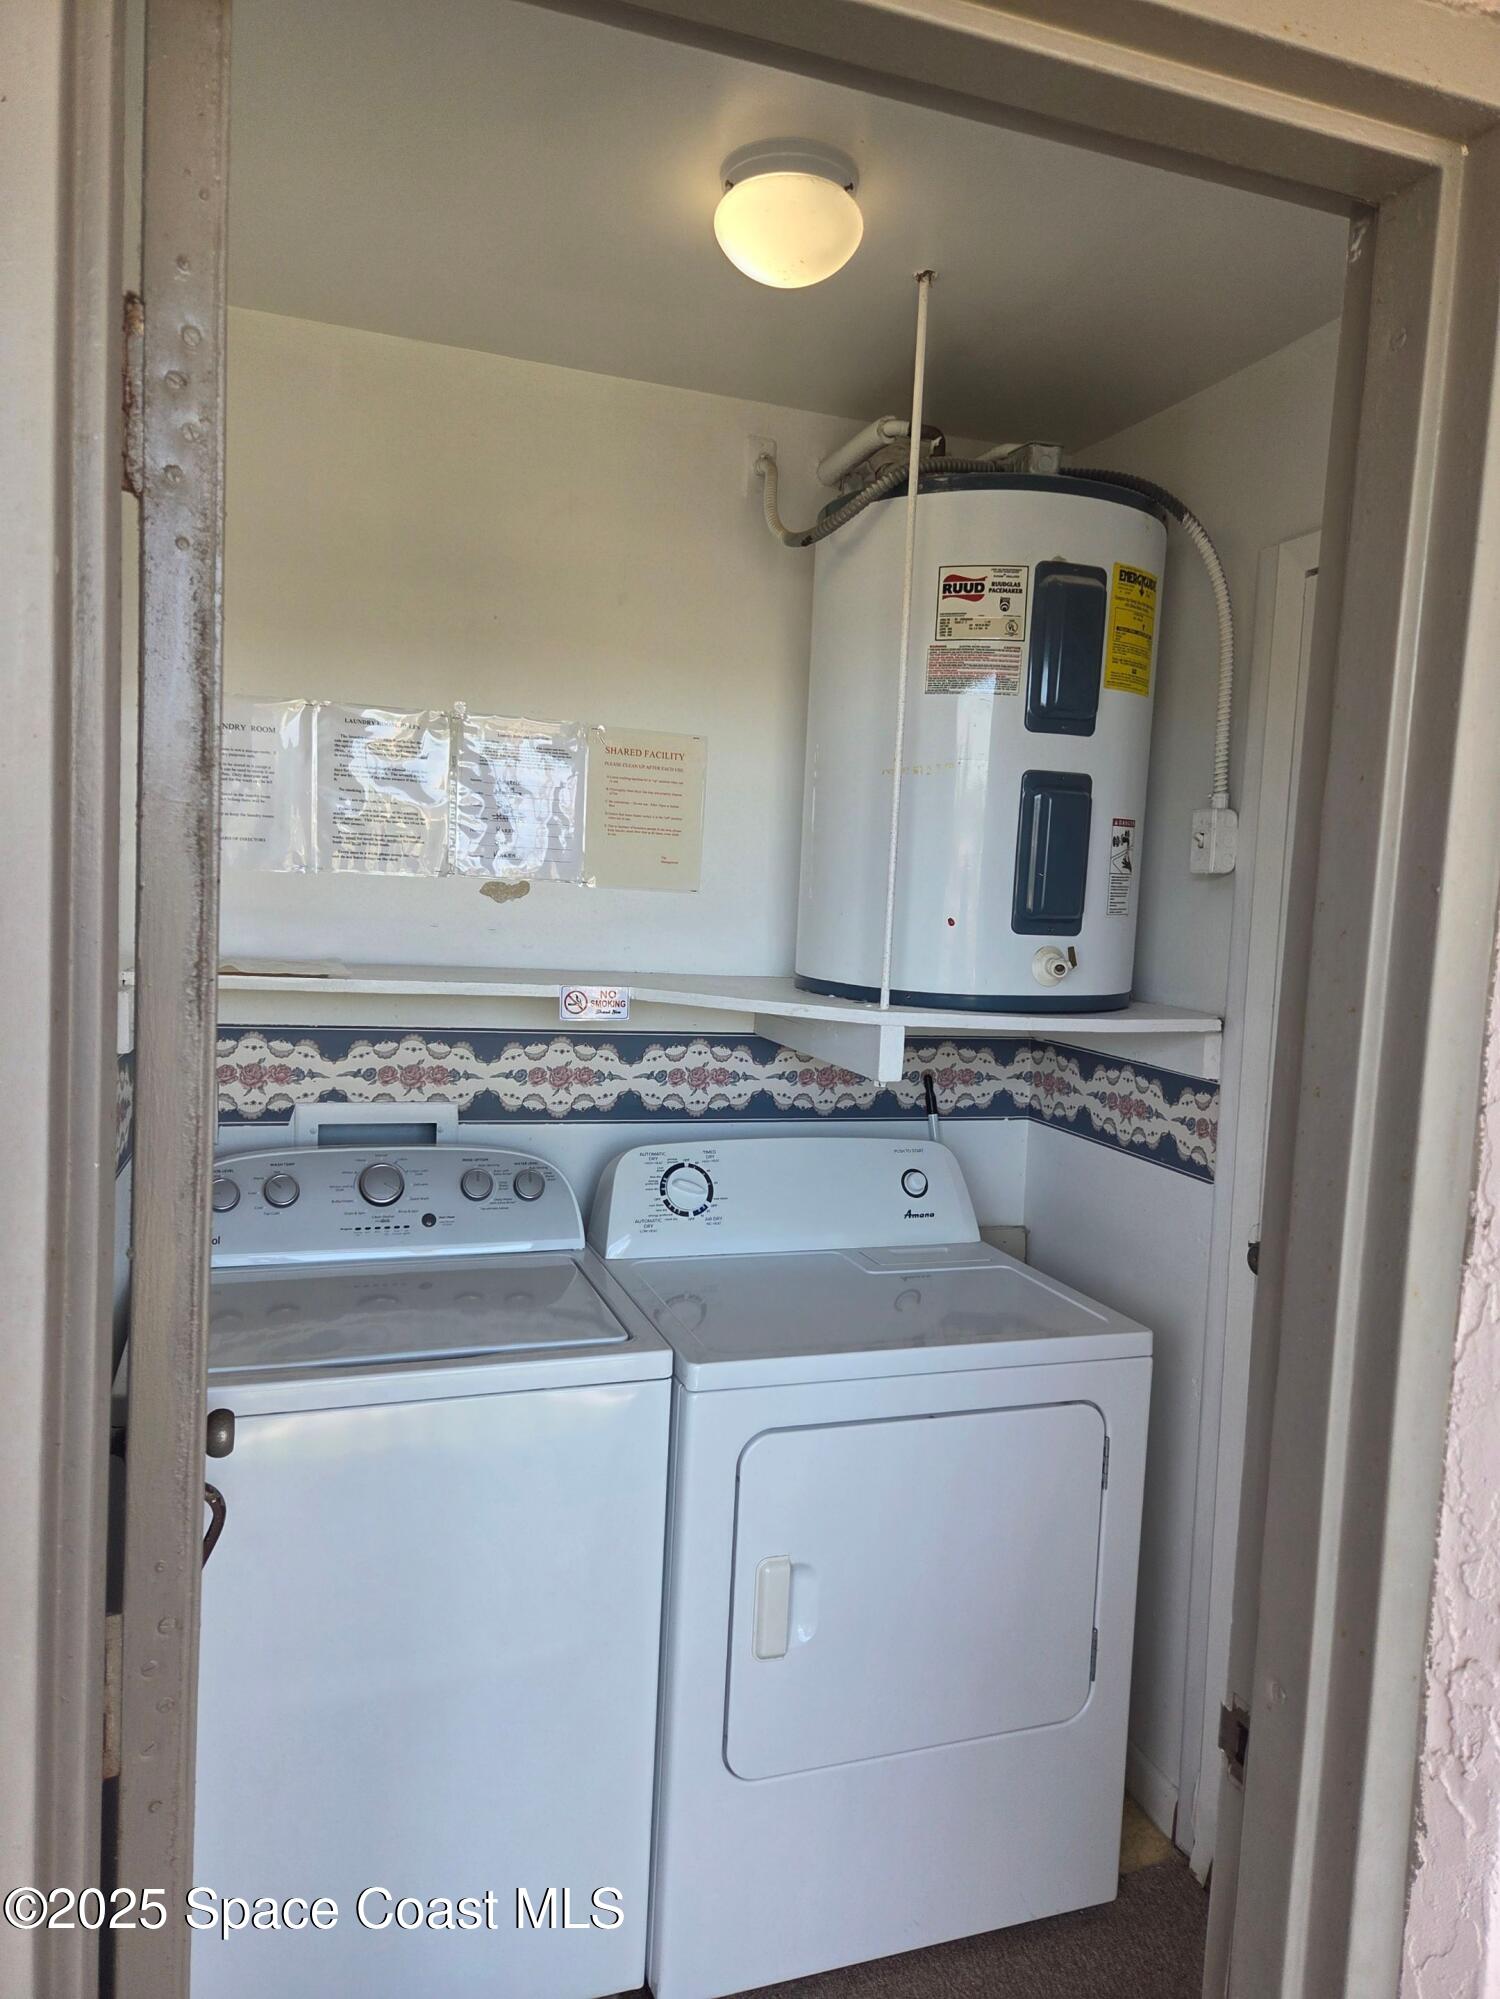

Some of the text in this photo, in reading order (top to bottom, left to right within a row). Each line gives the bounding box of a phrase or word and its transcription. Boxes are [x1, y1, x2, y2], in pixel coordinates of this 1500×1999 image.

[942, 583, 985, 594] RUUD
[344, 717, 375, 726] LAUNDRY
[251, 725, 276, 734] ROOM
[605, 746, 685, 761] SHARED FACILITY
[600, 990, 617, 999] NO
[591, 1000, 626, 1008] SMOKING
[903, 1209, 935, 1219] Amana
